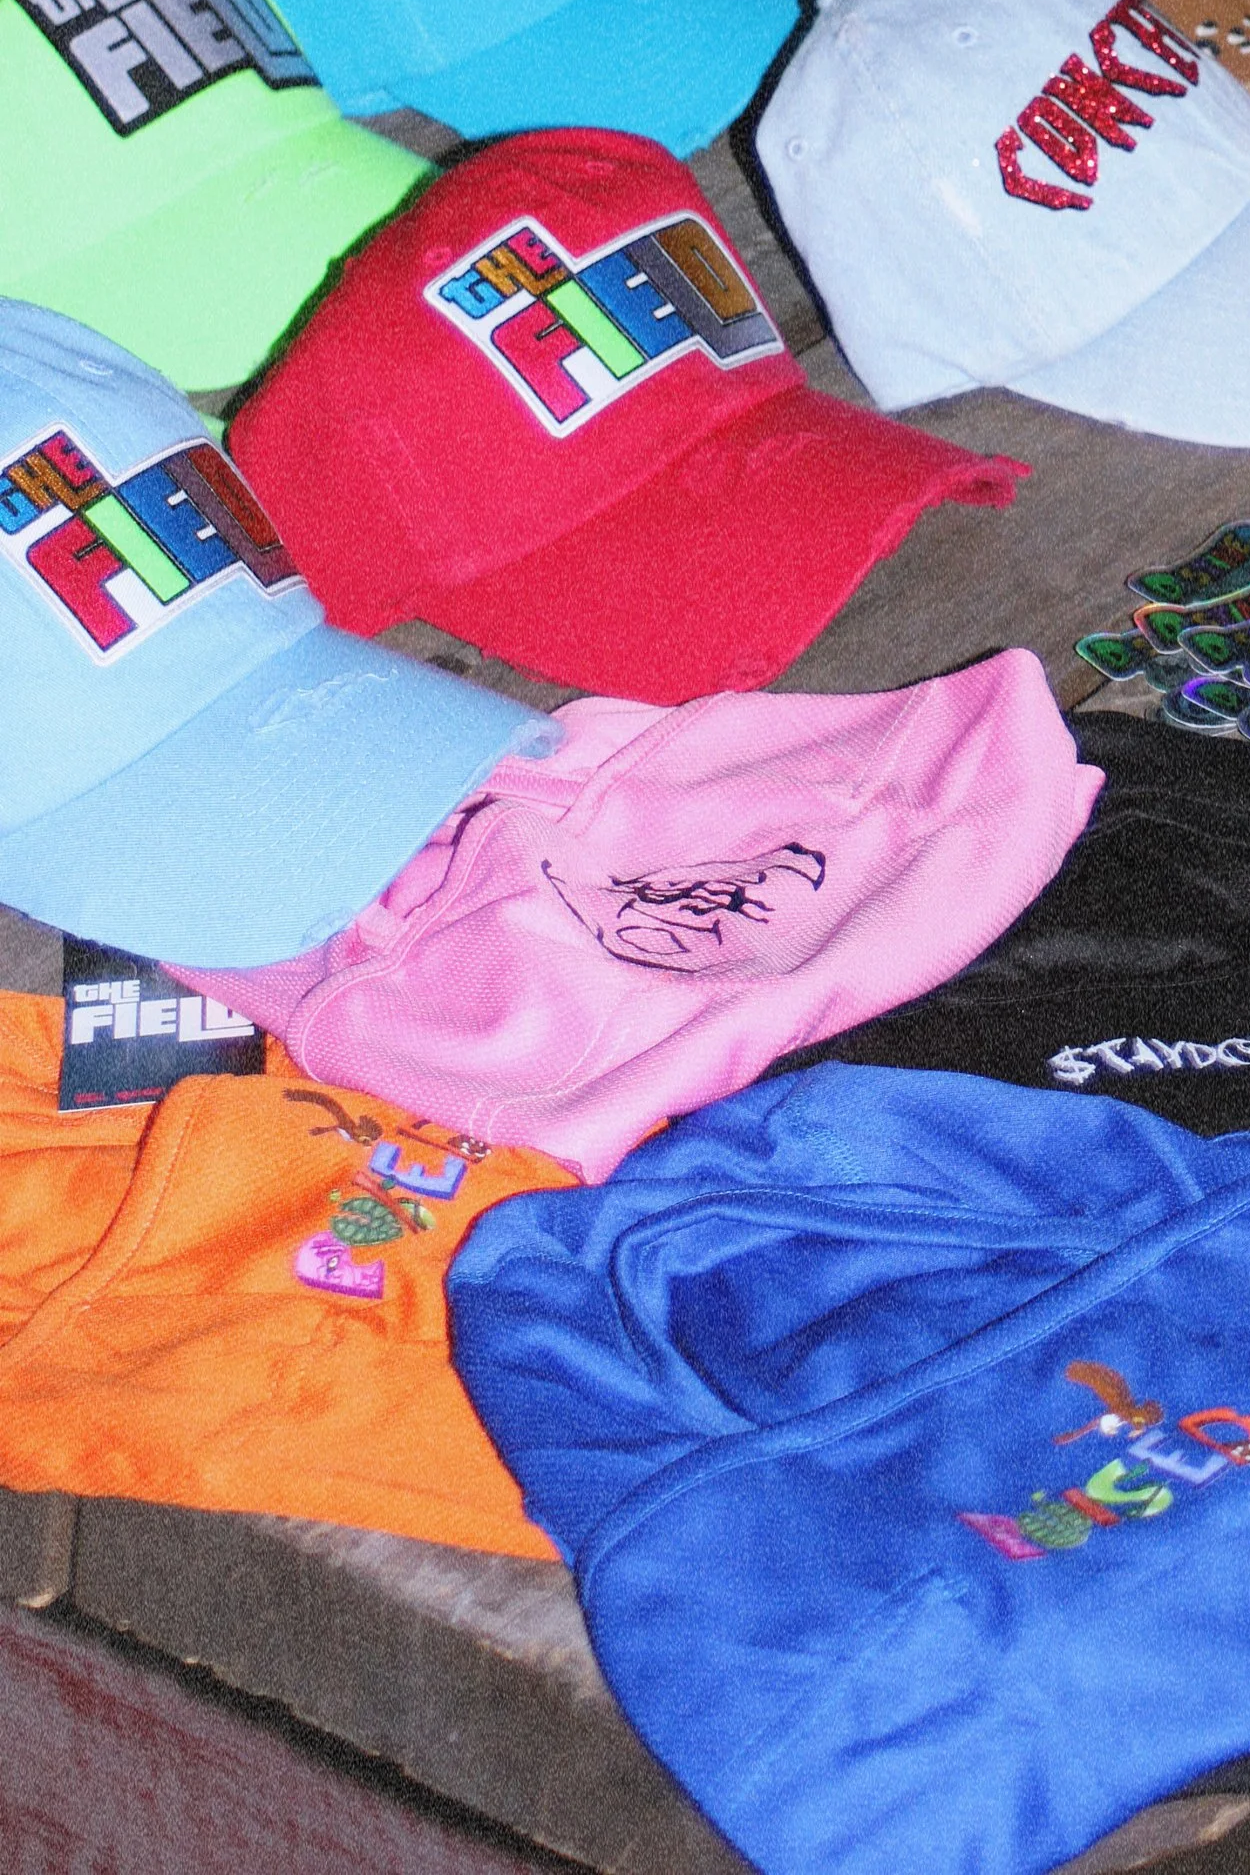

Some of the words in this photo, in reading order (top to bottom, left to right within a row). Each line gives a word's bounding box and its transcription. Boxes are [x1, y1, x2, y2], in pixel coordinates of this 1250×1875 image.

[440, 227, 570, 320] THE
[491, 219, 777, 424] FIELD
[26, 443, 302, 652] FIELD
[73, 980, 140, 1004] THE
